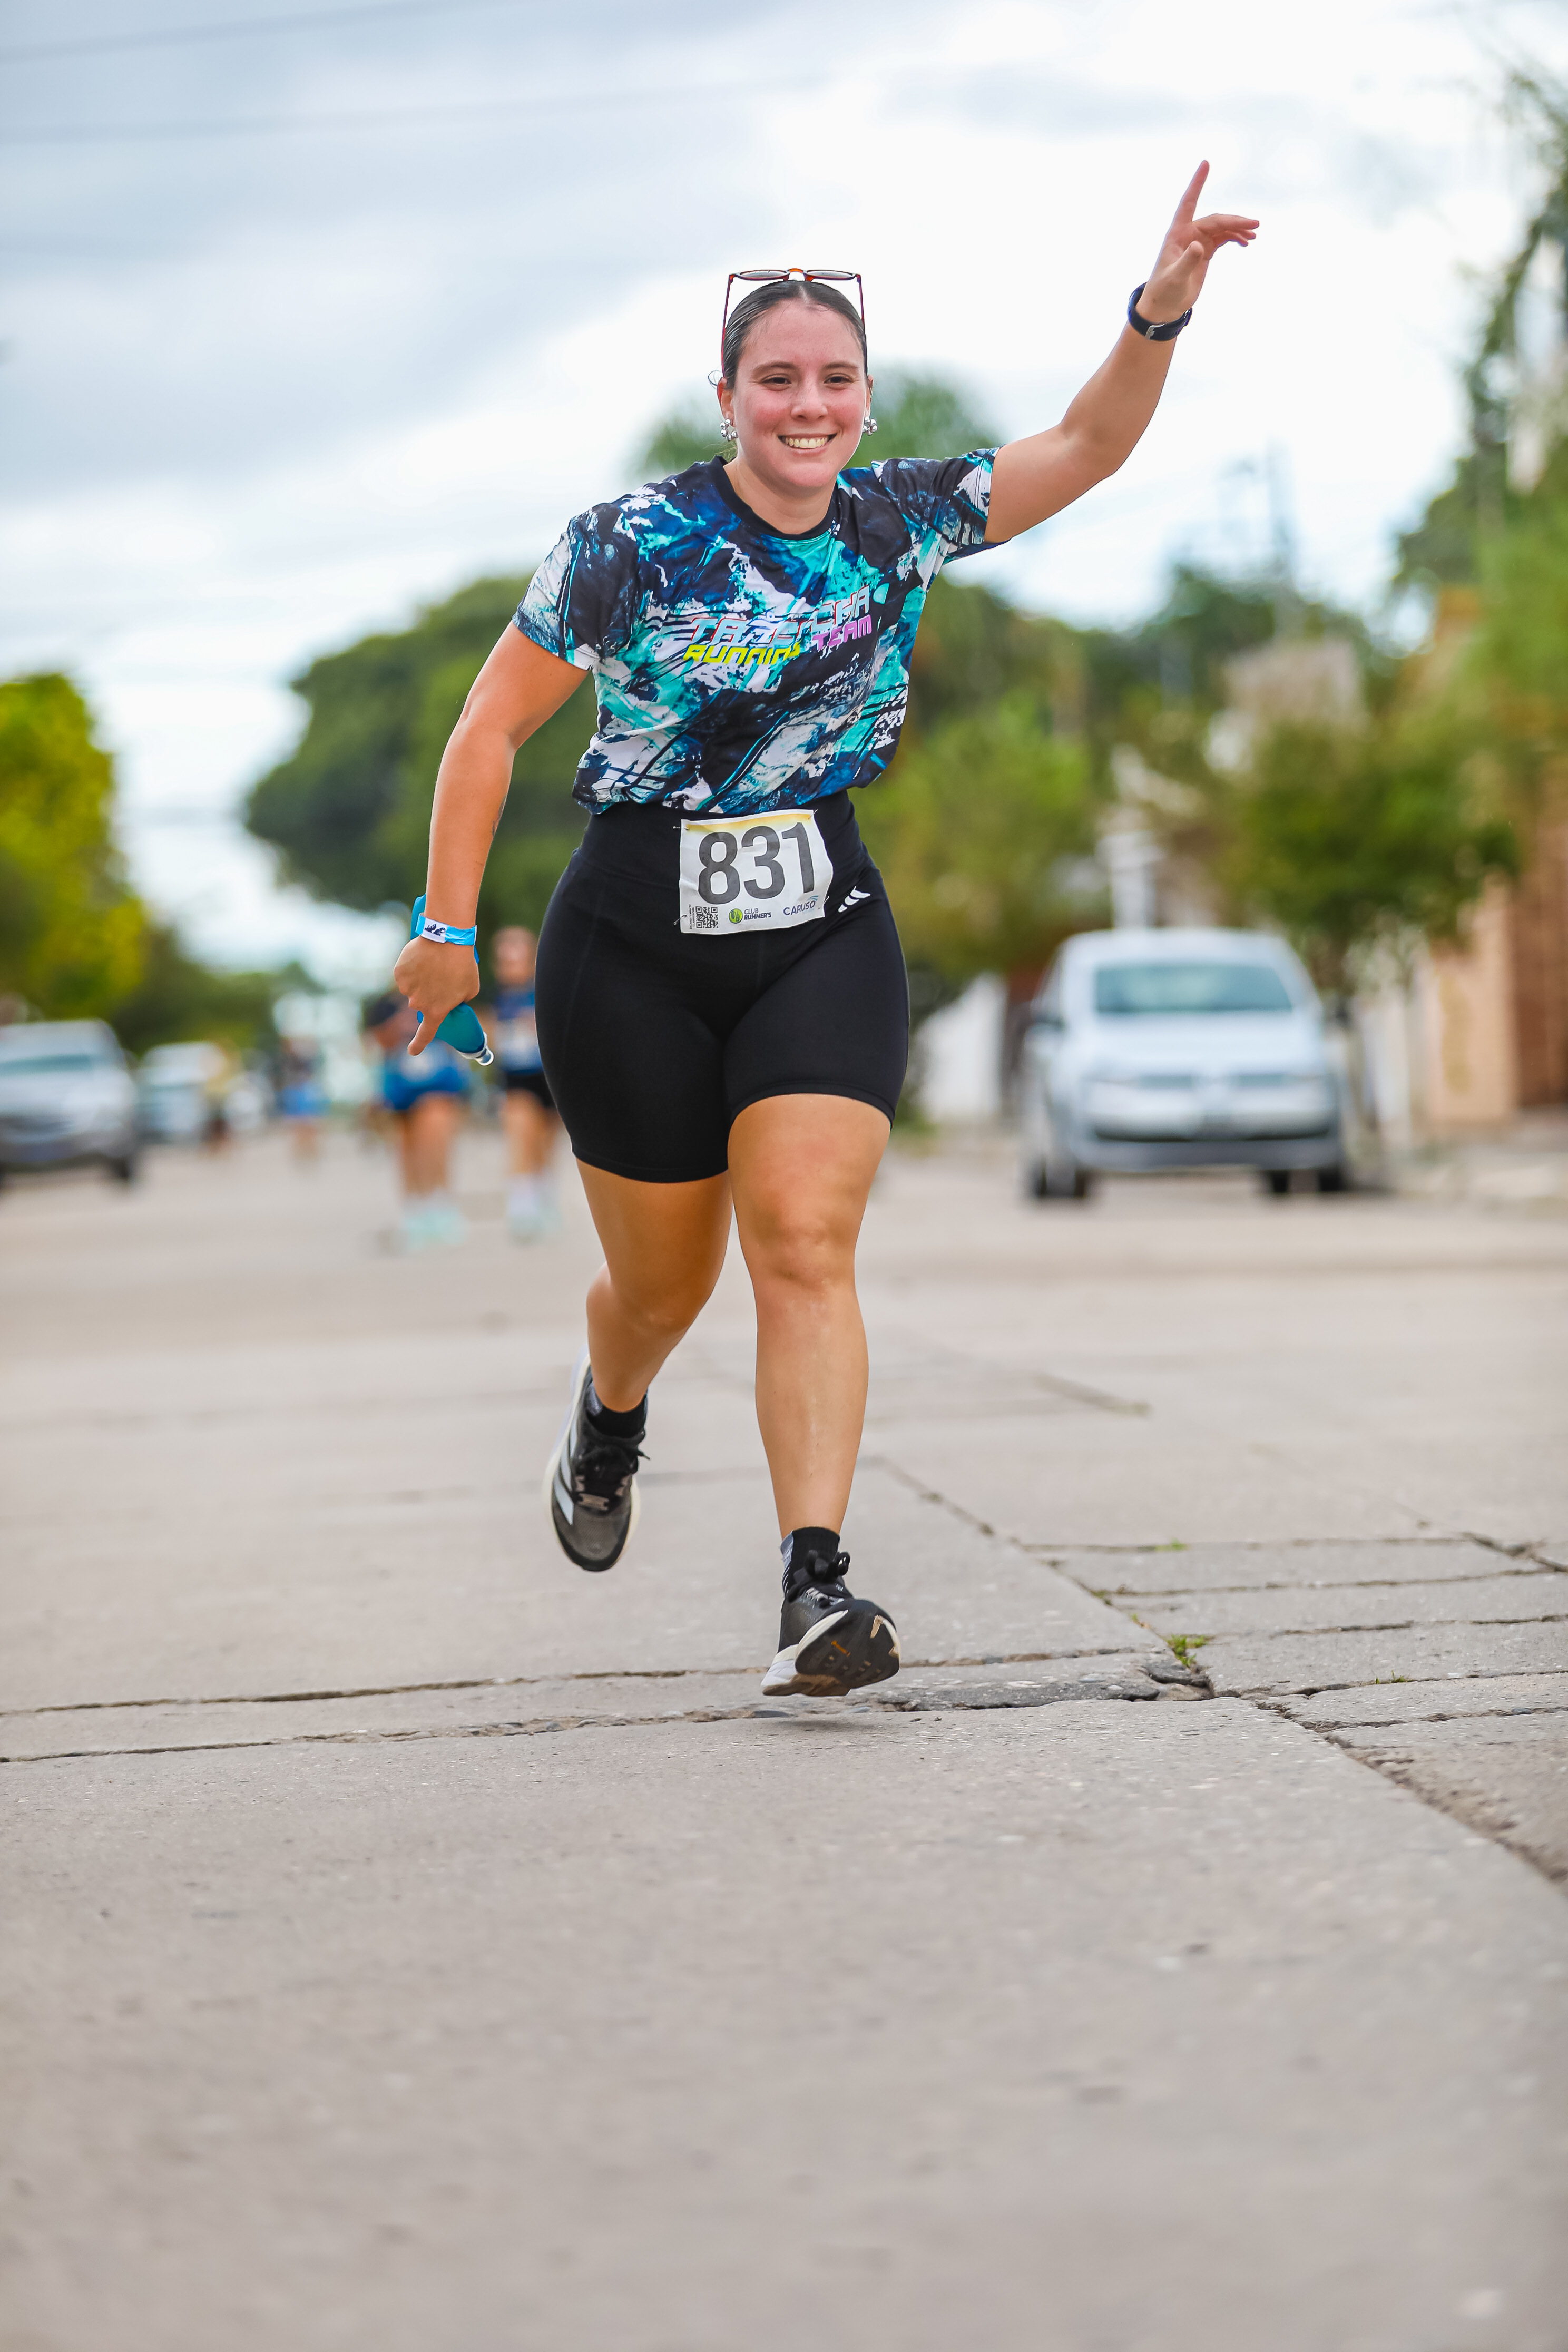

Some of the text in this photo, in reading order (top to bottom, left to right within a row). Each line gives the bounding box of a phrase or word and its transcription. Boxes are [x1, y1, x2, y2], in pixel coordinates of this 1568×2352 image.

[812, 614, 873, 651] TEAM
[698, 822, 815, 905] 831
[783, 900, 816, 916] CARUSO
